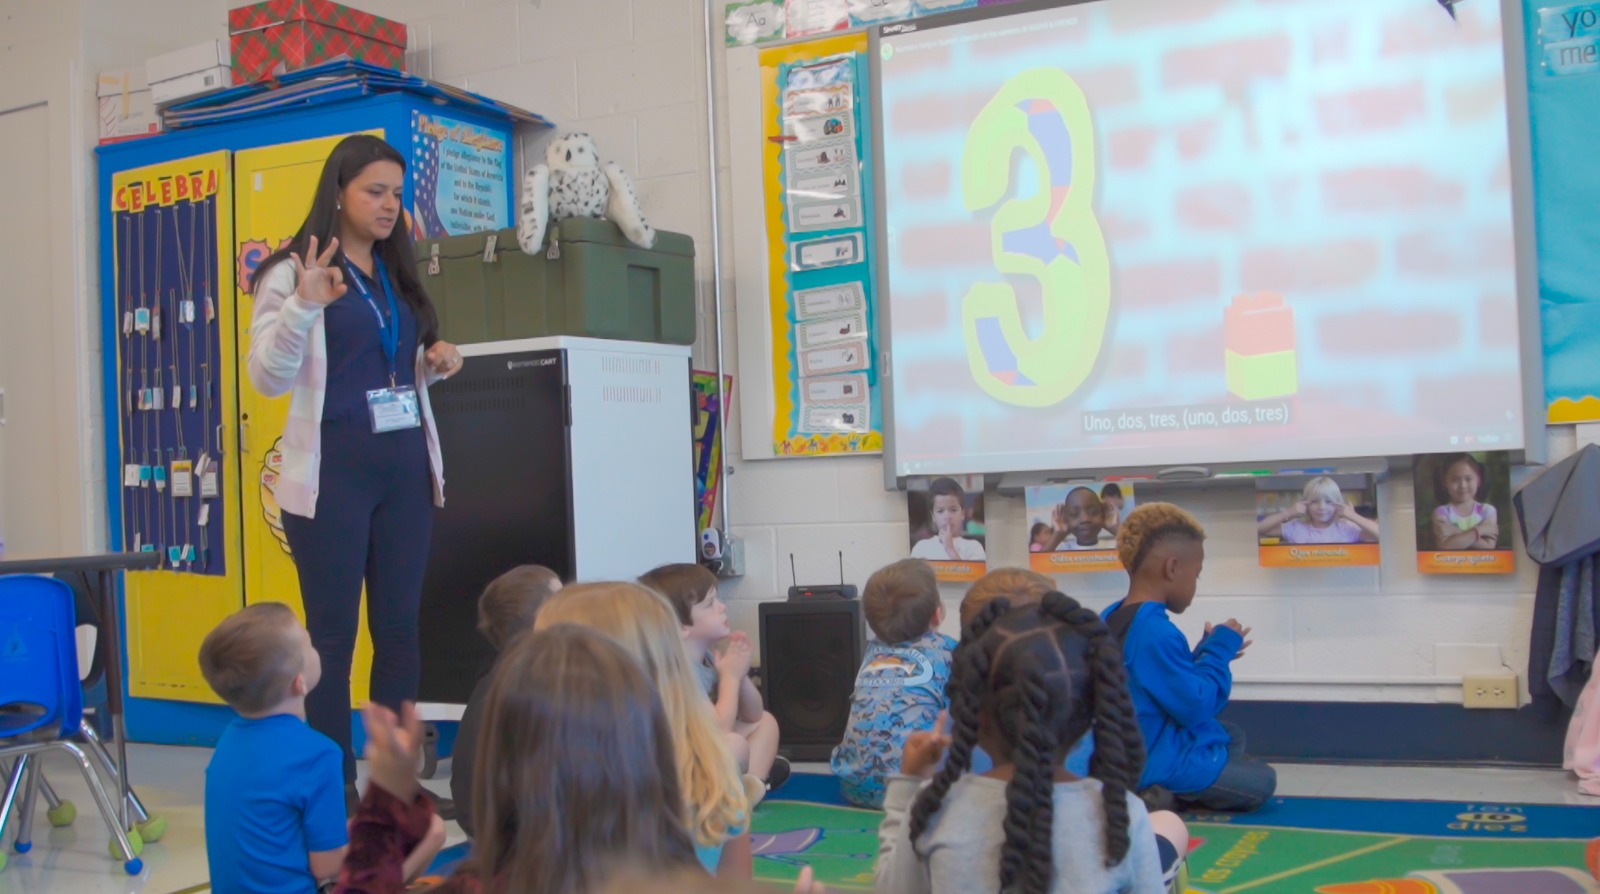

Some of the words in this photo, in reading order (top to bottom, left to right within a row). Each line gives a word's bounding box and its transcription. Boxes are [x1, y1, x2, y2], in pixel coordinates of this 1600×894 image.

[746, 13, 766, 27] Aa
[1561, 10, 1597, 38] yo
[1561, 45, 1598, 66] me
[116, 169, 217, 210] CELEBRA
[1084, 414, 1115, 433] Uno,
[1117, 412, 1147, 431] dos,
[1149, 412, 1180, 429] tres,
[1183, 408, 1219, 430] (uno,
[1221, 406, 1252, 425] dos,
[1254, 403, 1289, 425] tres)
